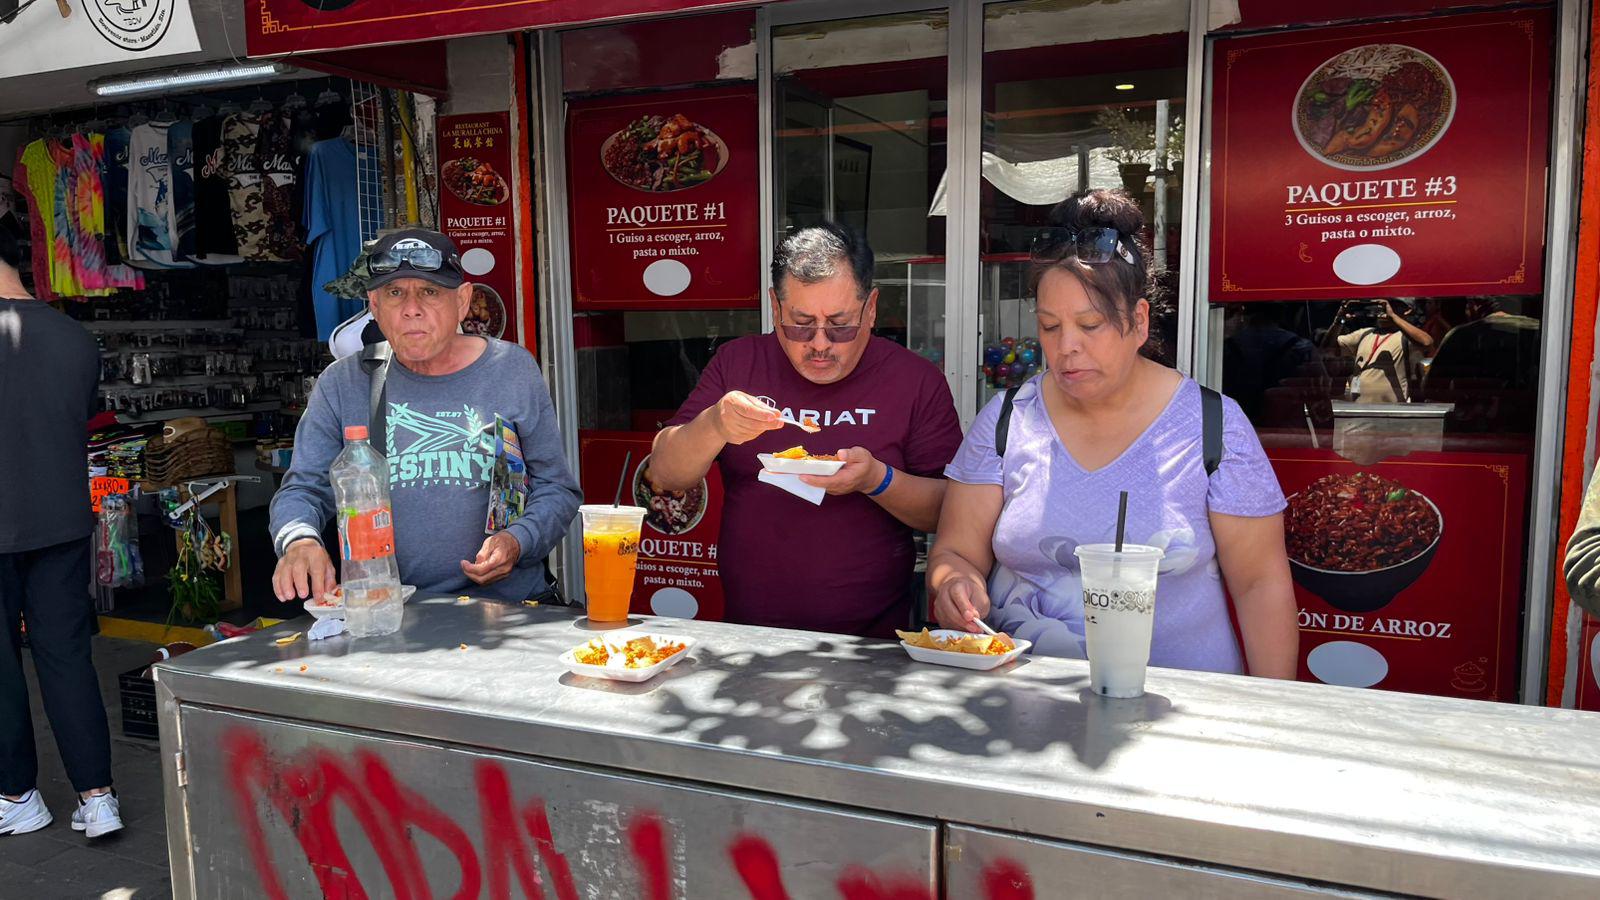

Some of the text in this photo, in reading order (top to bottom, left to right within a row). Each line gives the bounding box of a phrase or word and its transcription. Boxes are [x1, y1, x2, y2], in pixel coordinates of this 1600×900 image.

[1286, 176, 1457, 206] PAQUETE #3
[447, 216, 506, 228] PAQUETE #1
[606, 202, 726, 227] PAQUETE #1
[1284, 208, 1456, 226] 3 Guisos a escoger, arroz,
[609, 234, 613, 244] 1
[616, 233, 644, 243] Guiso
[655, 232, 692, 244] escoger,
[695, 231, 724, 242] arroz,
[1321, 226, 1416, 242] pasta o mixto.
[633, 247, 658, 259] pasta
[668, 246, 700, 256] mixto.
[781, 408, 876, 426] ARIAT
[386, 451, 495, 483] ESTINY
[636, 538, 703, 558] QUETE
[636, 562, 656, 572] uisos
[666, 566, 700, 576] escoger,
[644, 575, 666, 585] pasta
[676, 577, 704, 588] mixto.
[1332, 614, 1364, 631] DE
[1370, 617, 1451, 639] ARROZ
